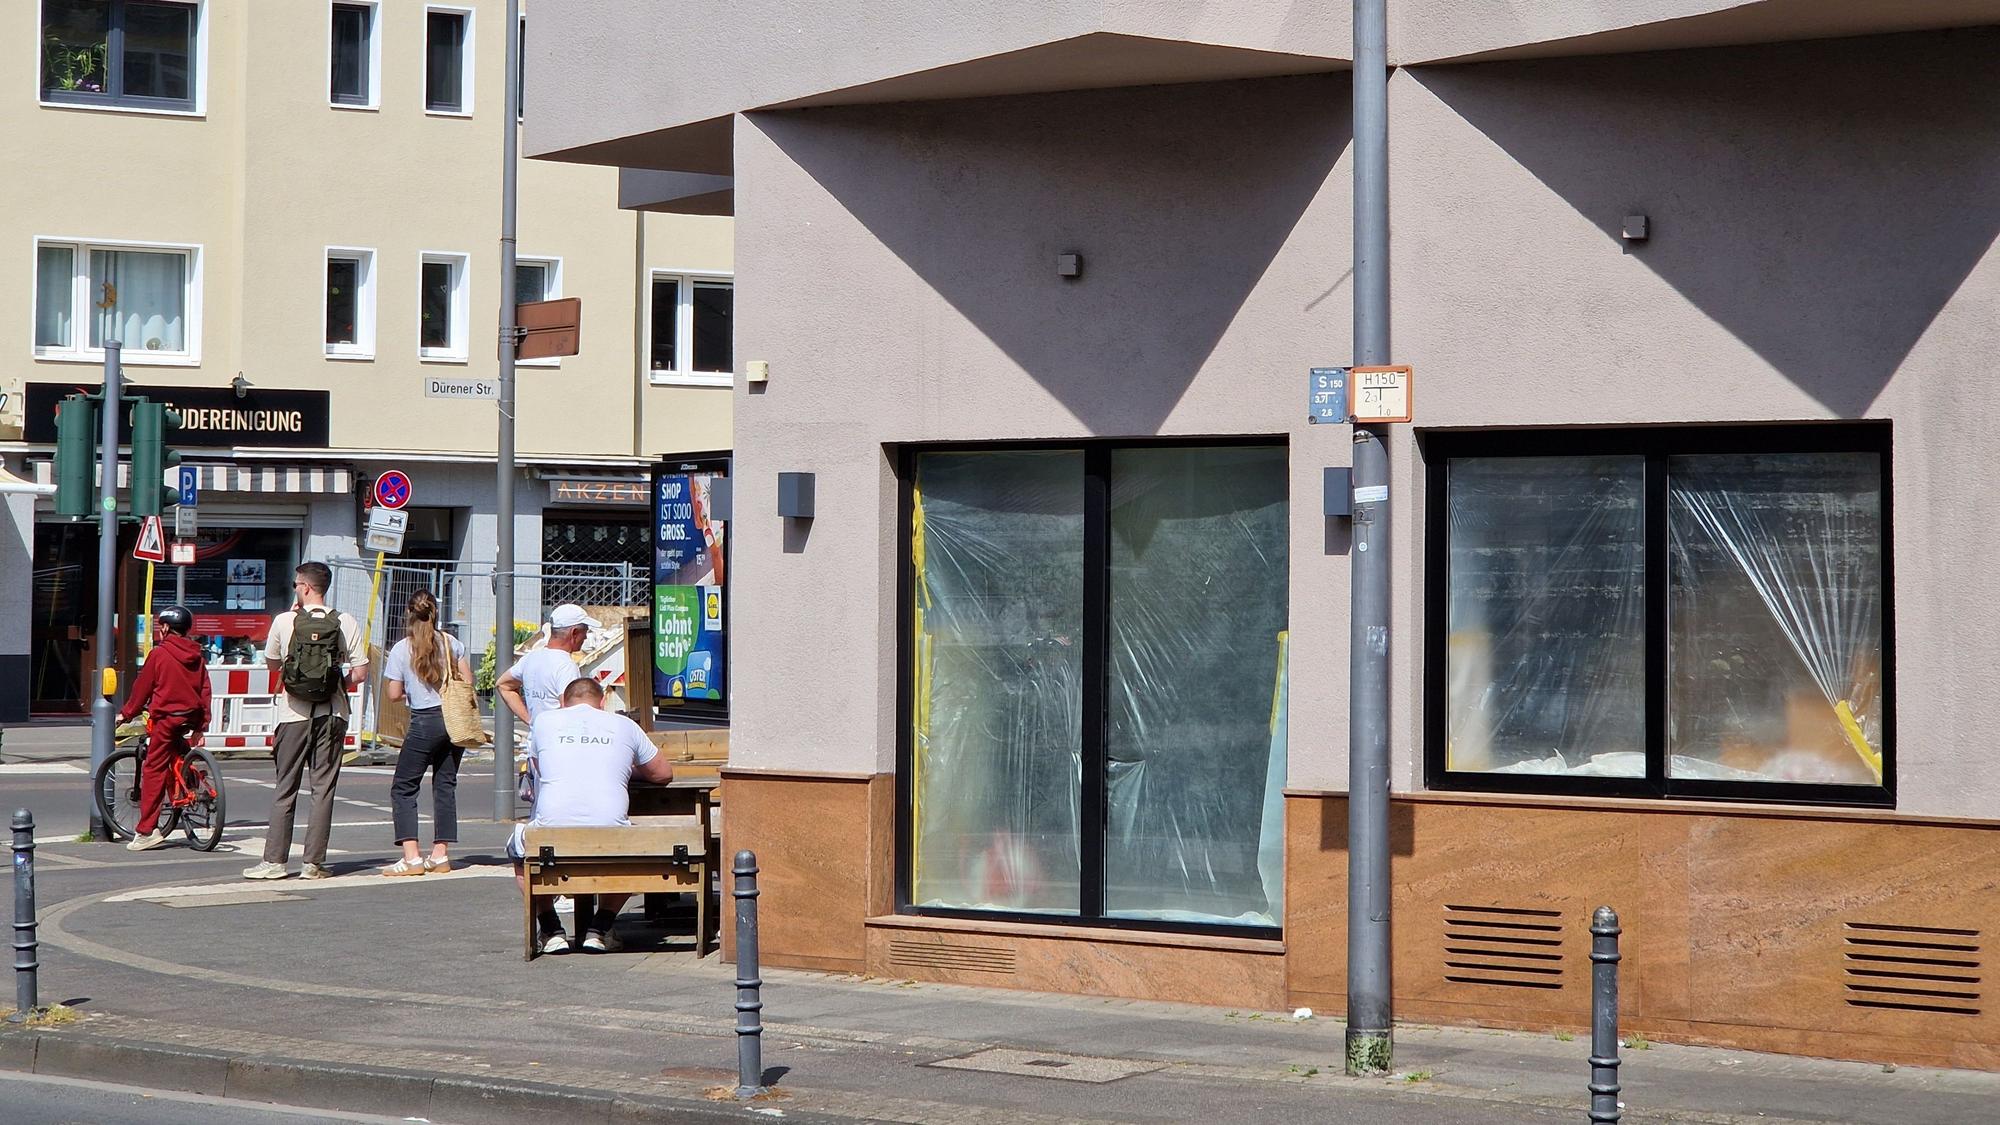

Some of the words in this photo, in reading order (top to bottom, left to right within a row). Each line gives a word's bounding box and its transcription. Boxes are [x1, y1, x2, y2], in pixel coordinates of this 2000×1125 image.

[432, 381, 473, 394] Dürener
[476, 383, 494, 395] Str.
[1319, 376, 1327, 388] S
[1330, 380, 1343, 389] 150
[129, 402, 302, 432] UDEREINIGUNG
[661, 483, 681, 500] SHOP
[660, 503, 671, 520] IST
[673, 503, 692, 520] SOOO
[659, 614, 692, 635] Lohnt
[558, 736, 575, 744] TS
[580, 736, 610, 745] BAU
